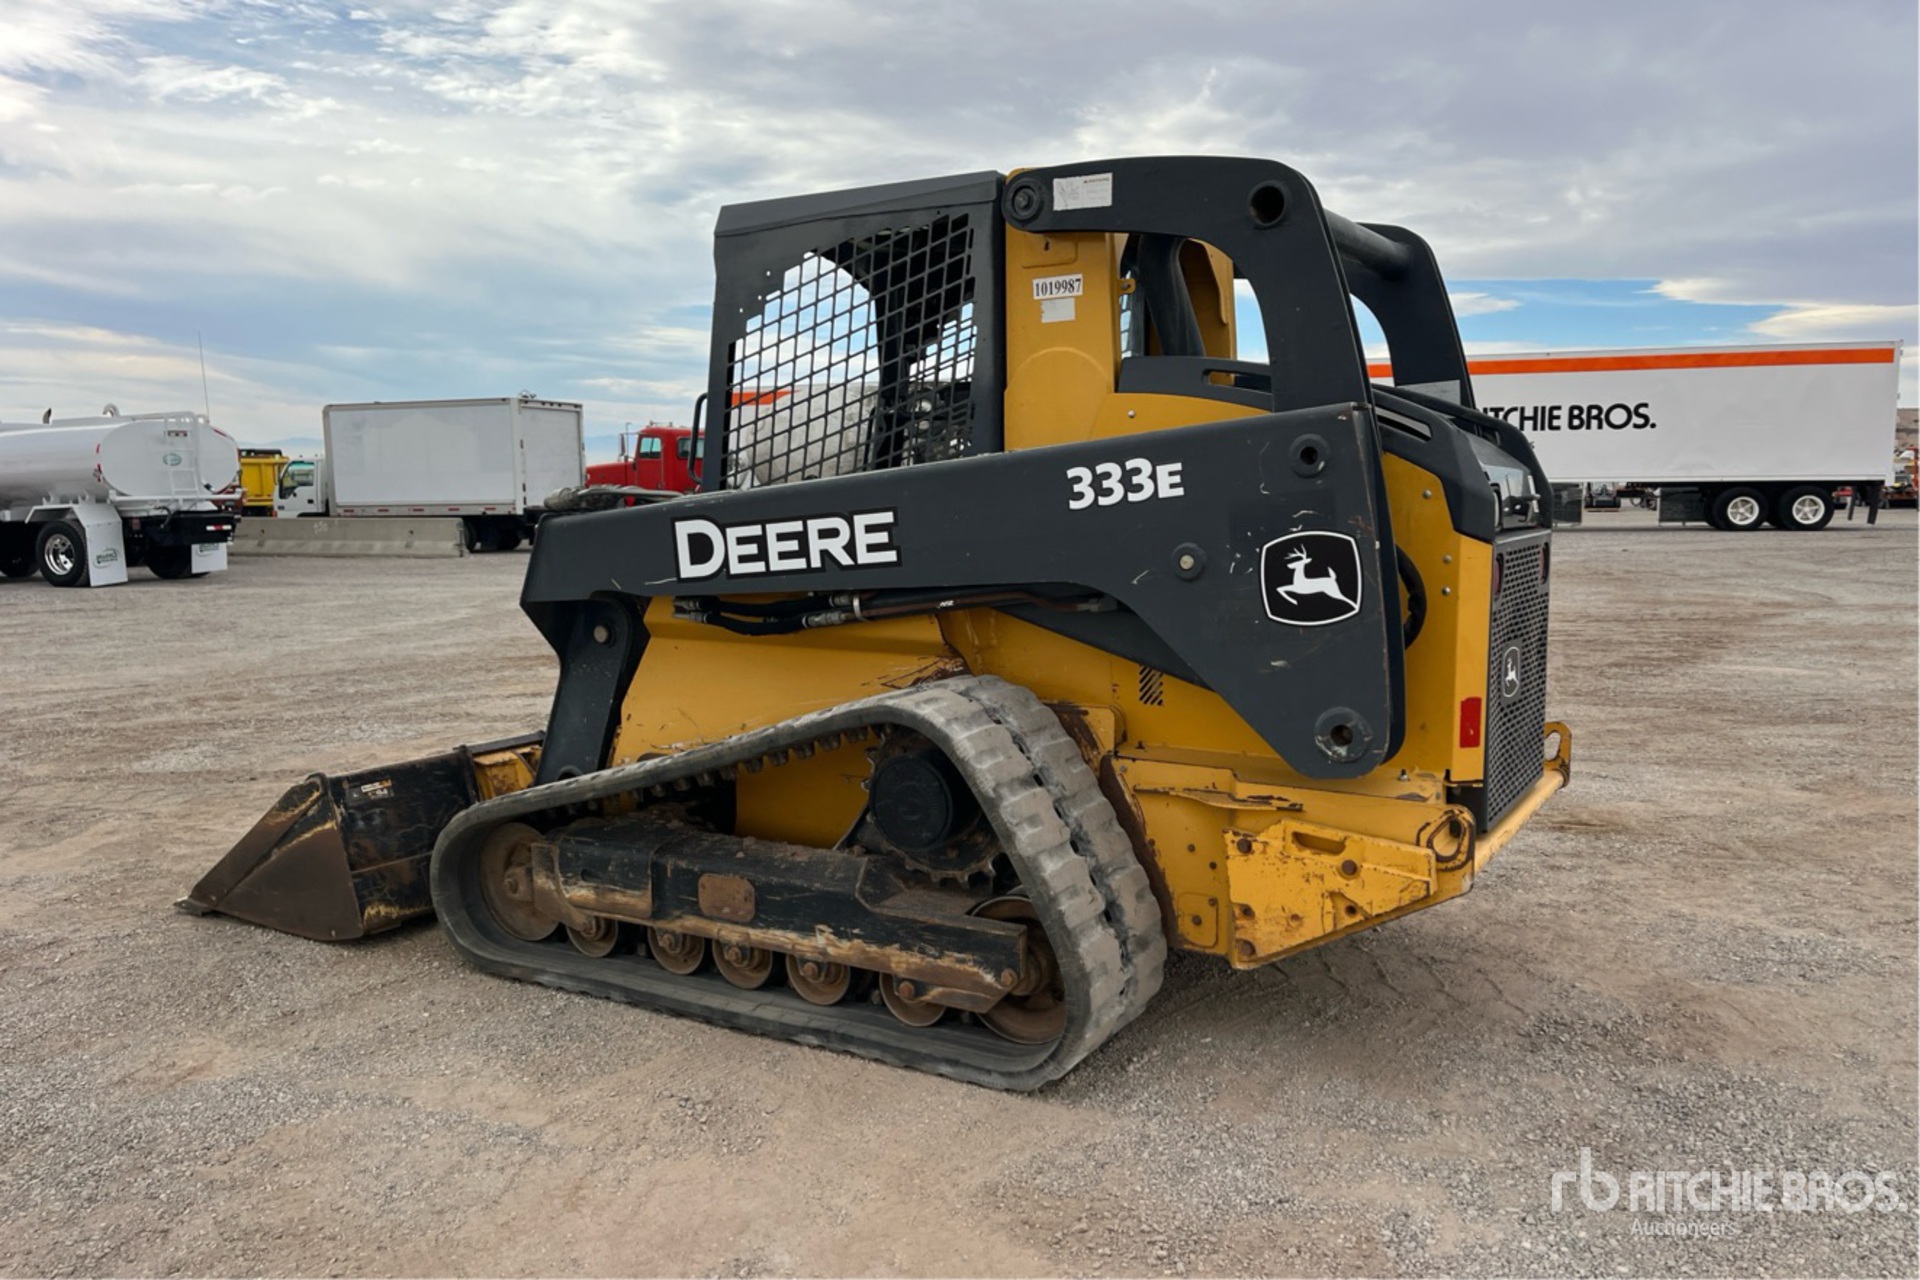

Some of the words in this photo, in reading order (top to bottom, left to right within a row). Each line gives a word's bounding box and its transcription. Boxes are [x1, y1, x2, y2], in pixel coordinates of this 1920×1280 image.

[1035, 278, 1082, 297] 1019987
[1567, 402, 1657, 430] BROS.
[1066, 457, 1185, 510] 333E
[674, 510, 898, 579] DEERE
